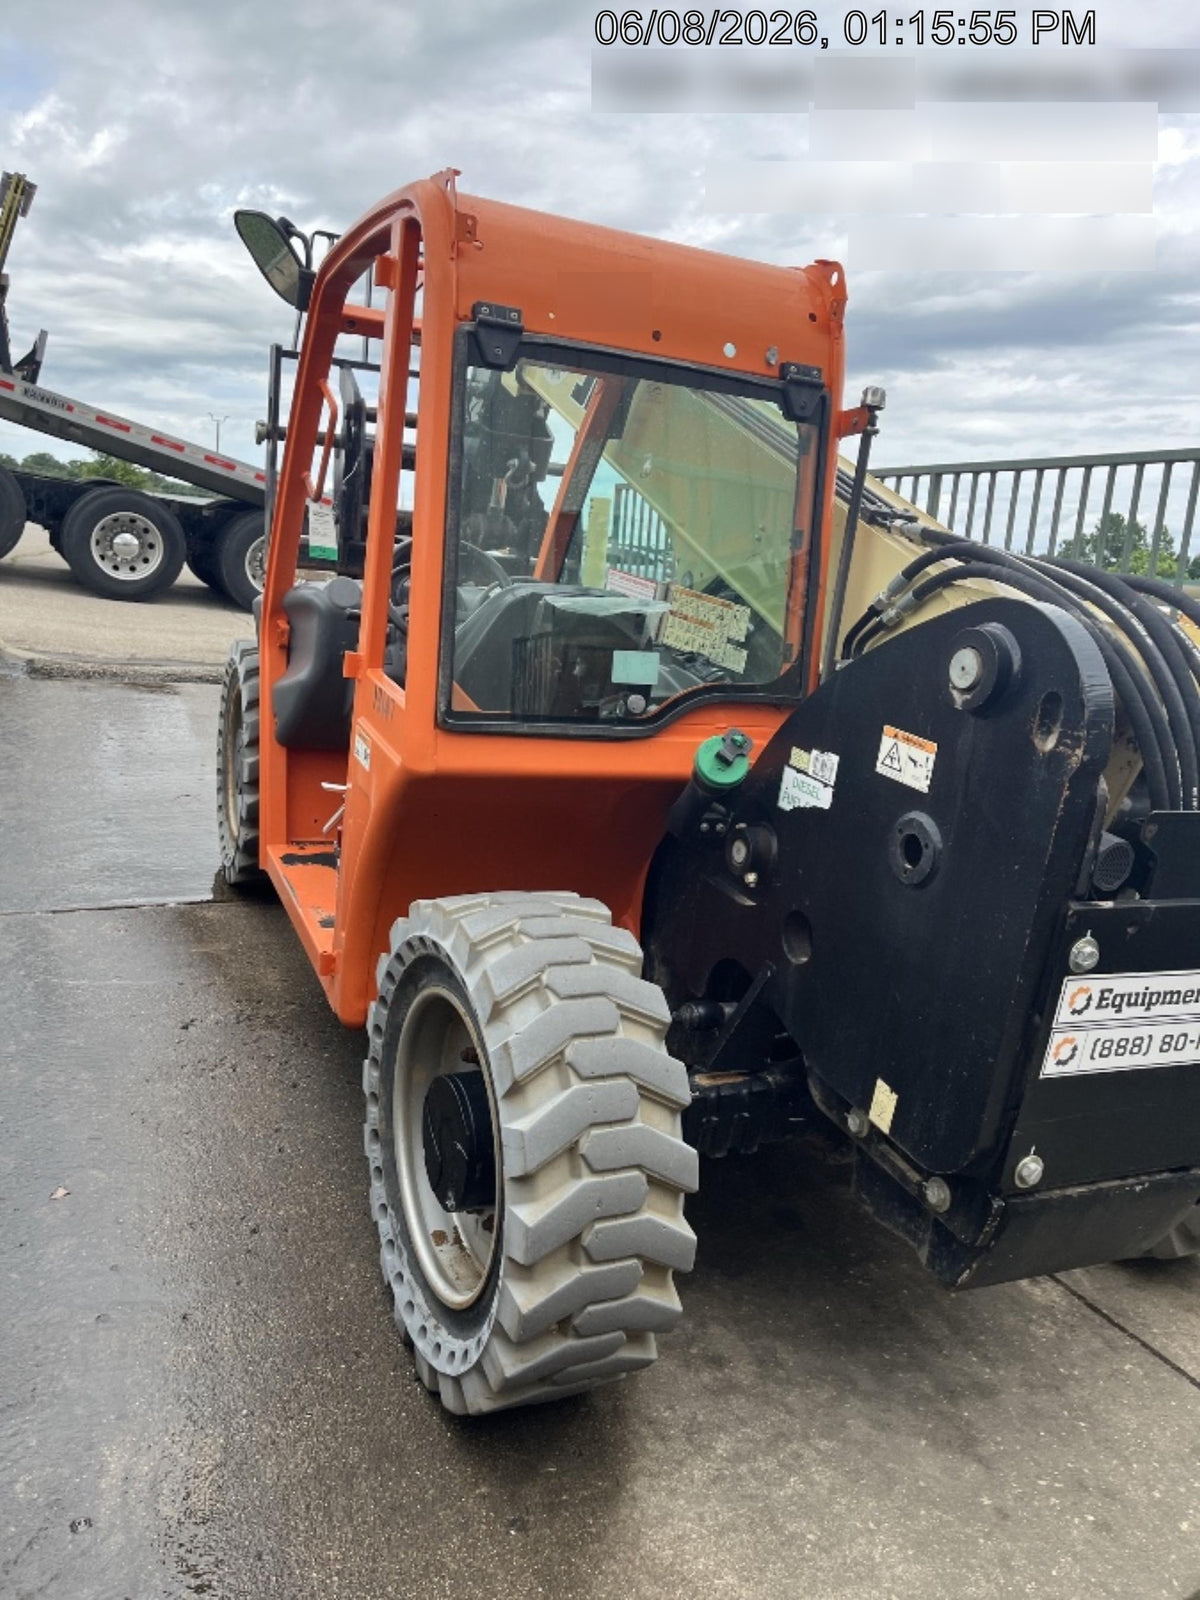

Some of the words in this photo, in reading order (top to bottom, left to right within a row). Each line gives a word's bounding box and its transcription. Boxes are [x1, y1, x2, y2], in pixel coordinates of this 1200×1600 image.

[793, 776, 821, 801] DIESEL
[1090, 1034, 1153, 1060] (888)
[1159, 1032, 1200, 1053] 80-
